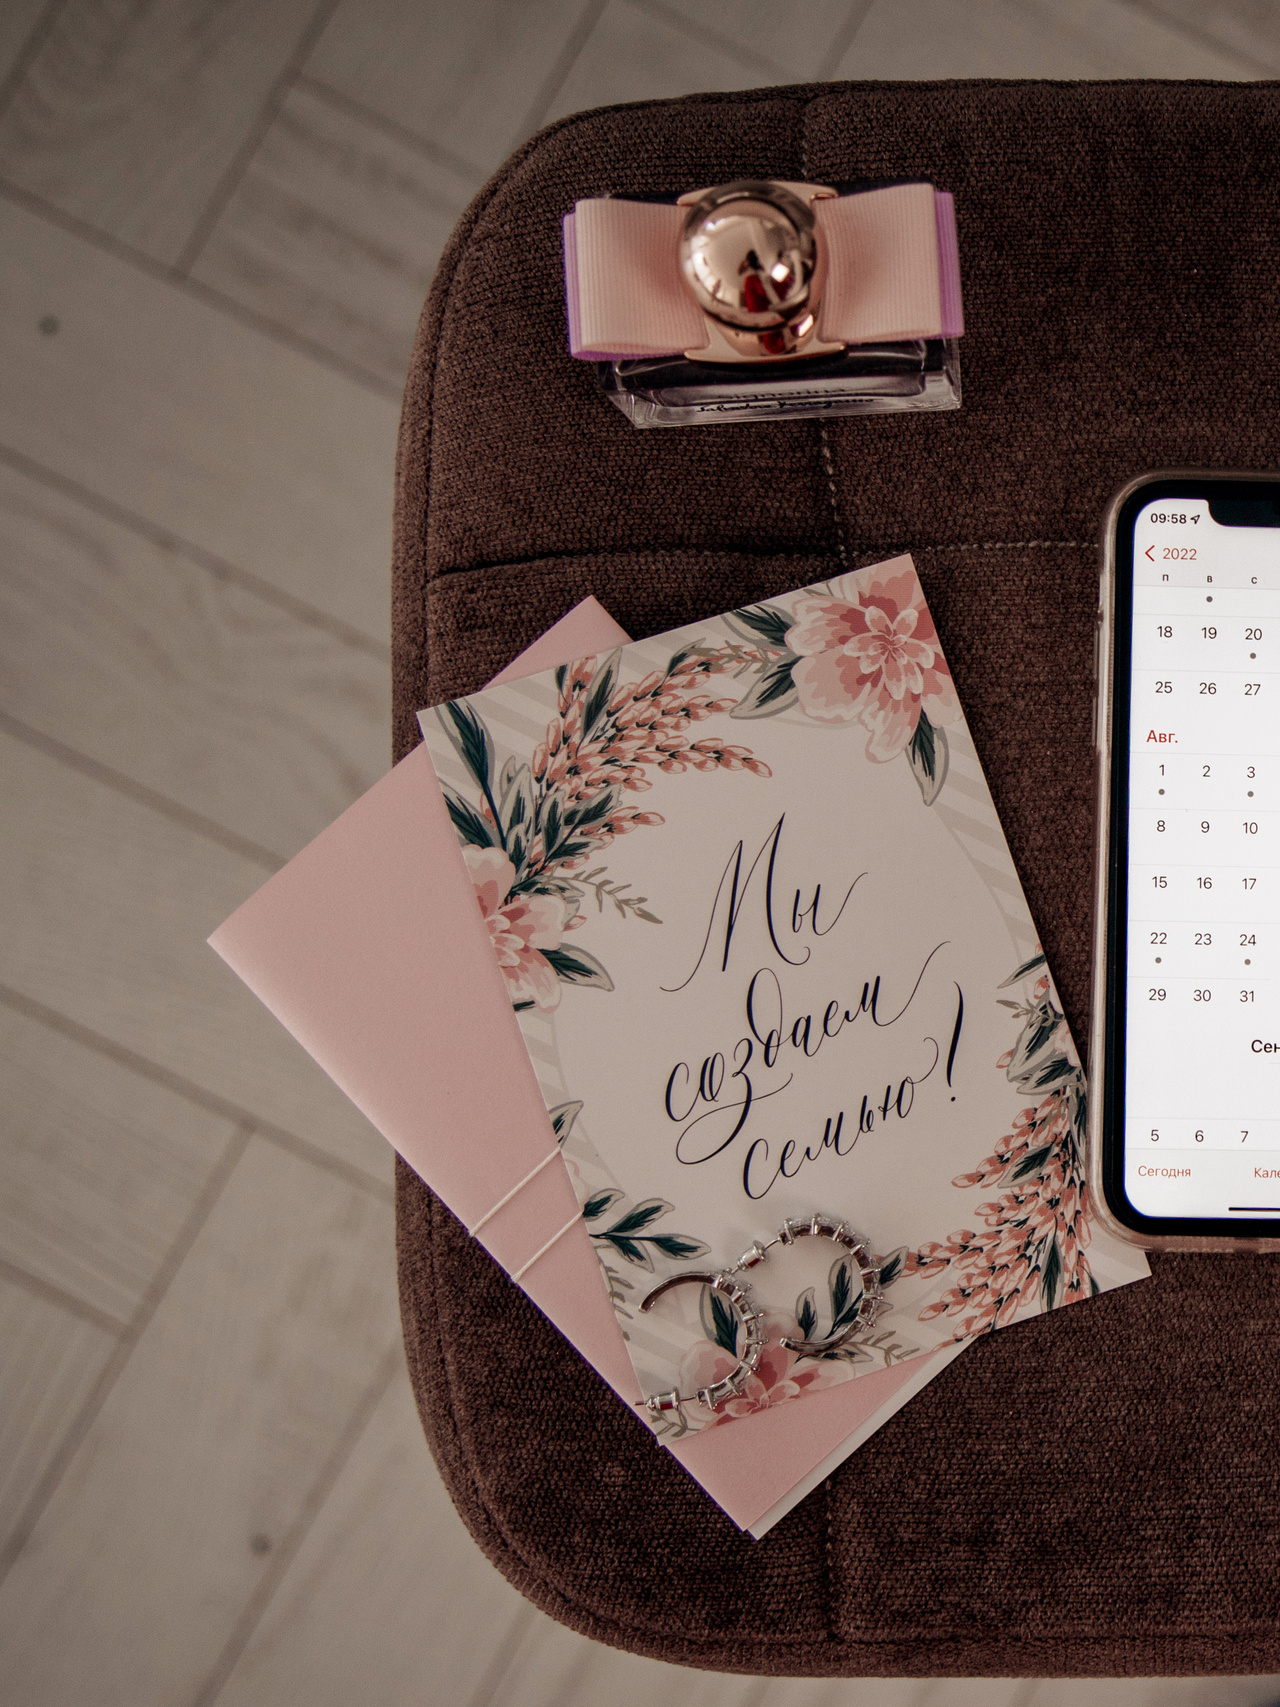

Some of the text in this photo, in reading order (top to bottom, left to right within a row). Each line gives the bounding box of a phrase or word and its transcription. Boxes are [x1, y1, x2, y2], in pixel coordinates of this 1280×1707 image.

[1150, 512, 1187, 526] 09:58
[1162, 547, 1198, 562] 2022
[1156, 625, 1173, 639] 18
[1200, 626, 1218, 640] 19
[1244, 627, 1263, 641] 20
[1154, 680, 1173, 695] 25
[1198, 681, 1217, 696] 26
[1244, 683, 1262, 696] 27
[1146, 730, 1178, 744] Авг.
[1158, 763, 1165, 777] 1
[1202, 764, 1211, 778] 2
[1246, 765, 1256, 779] 3
[1156, 819, 1166, 833] 8
[1200, 820, 1211, 834] 9
[1242, 821, 1259, 835] 10
[1151, 875, 1168, 889] 15
[1196, 876, 1213, 890] 16
[1241, 877, 1257, 891] 17
[660, 812, 868, 992] Мы
[1149, 931, 1168, 945] 22
[1194, 932, 1213, 946] 23
[1239, 933, 1257, 947] 24
[1148, 987, 1255, 1003] 29 30 31
[665, 941, 951, 1165] создаем
[743, 981, 964, 1200] семью!
[1150, 1128, 1160, 1143] 5
[1194, 1129, 1205, 1143] 6
[1240, 1130, 1249, 1144] 7
[1137, 1164, 1192, 1179] Сегодня
